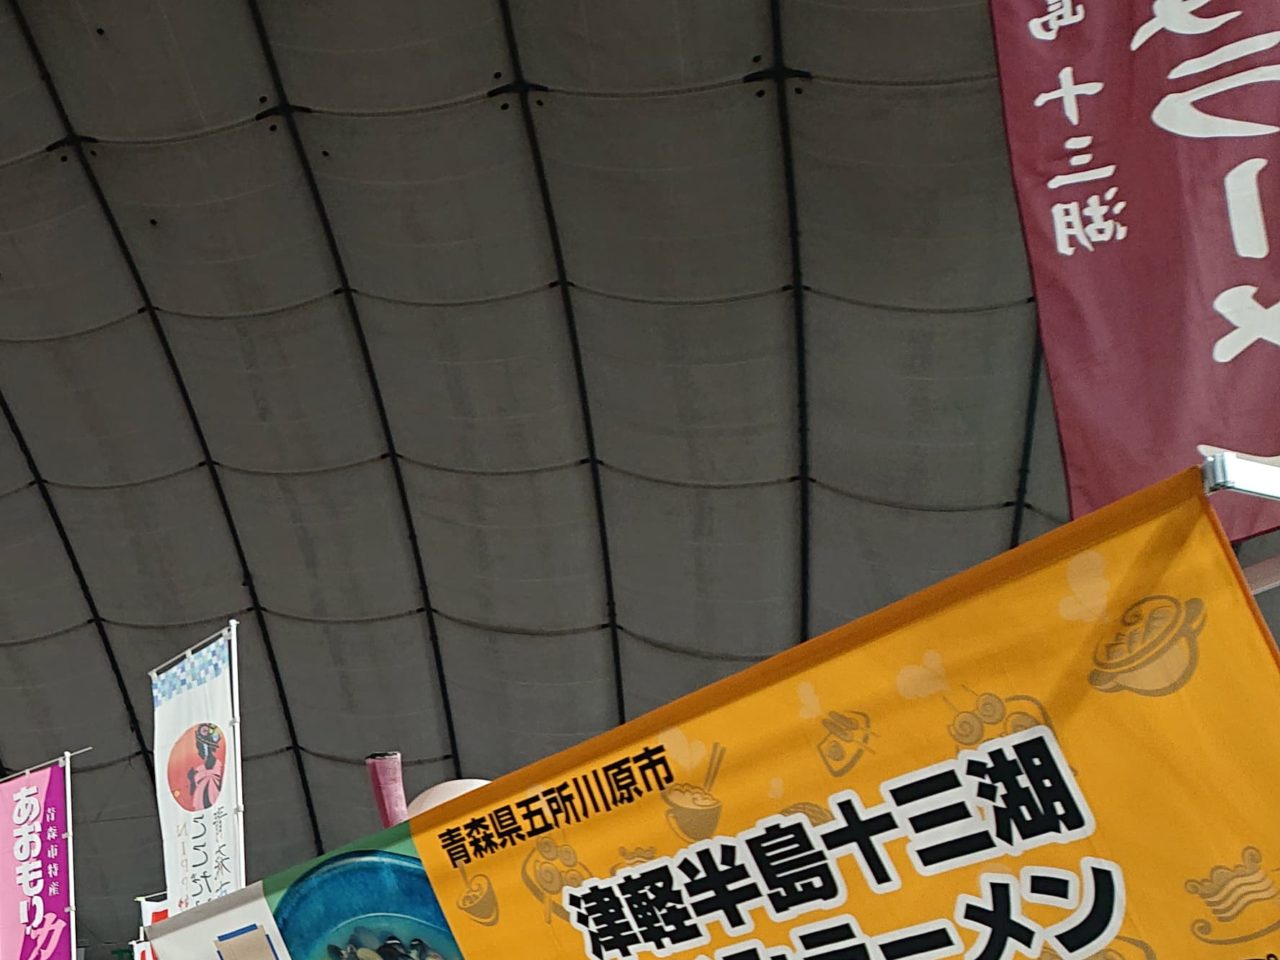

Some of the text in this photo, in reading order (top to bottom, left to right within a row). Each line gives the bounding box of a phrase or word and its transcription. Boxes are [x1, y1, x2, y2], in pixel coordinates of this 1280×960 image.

[438, 743, 675, 870] 青森県五所川原市
